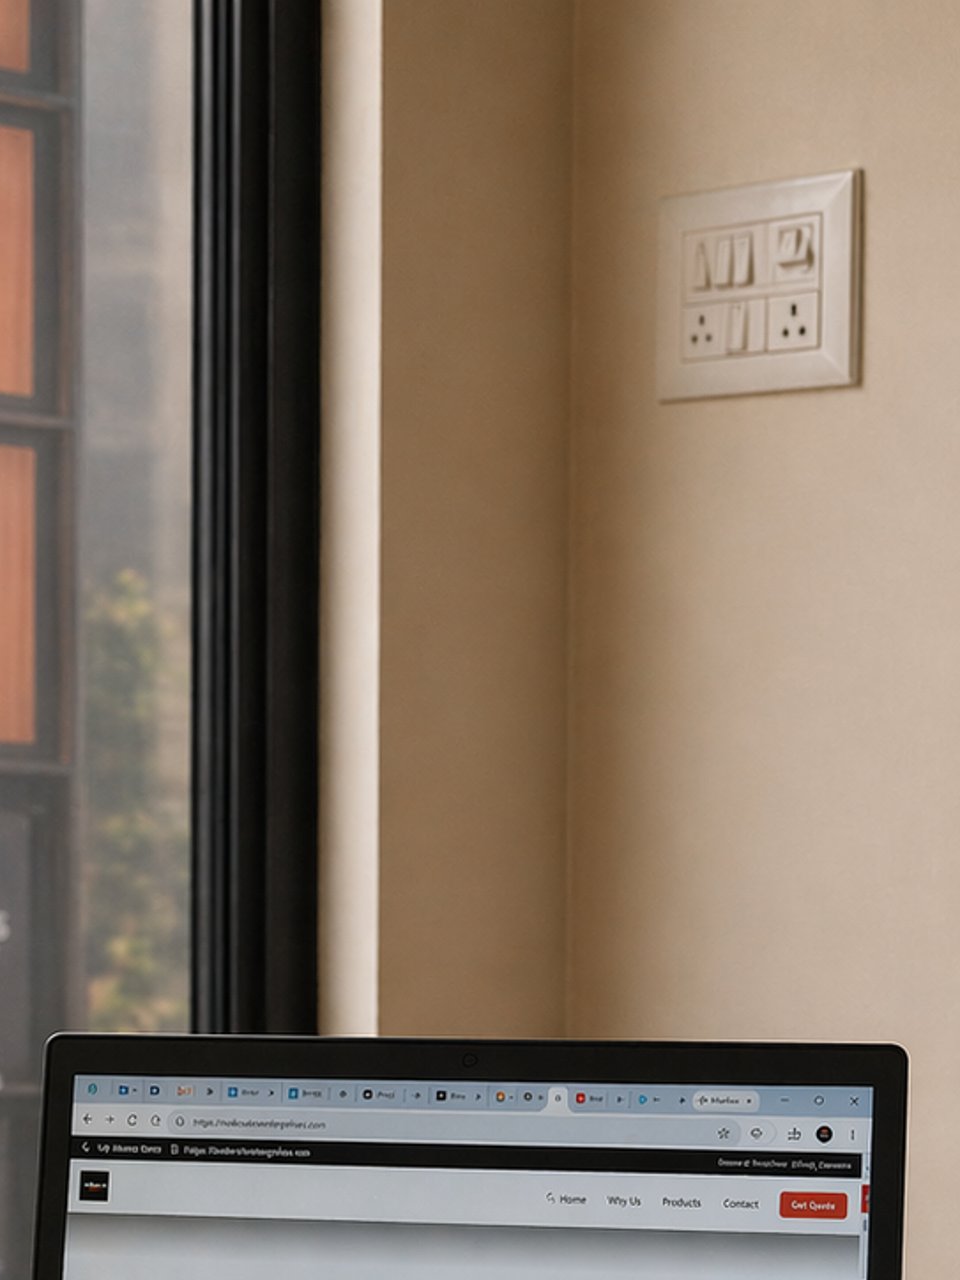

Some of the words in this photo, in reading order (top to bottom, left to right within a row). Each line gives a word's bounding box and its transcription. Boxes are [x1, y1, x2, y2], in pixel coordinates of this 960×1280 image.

[560, 1195, 587, 1204] Home
[607, 1196, 627, 1208] Why
[629, 1196, 641, 1206] Us
[662, 1197, 701, 1208] Products
[723, 1199, 759, 1209] Contact
